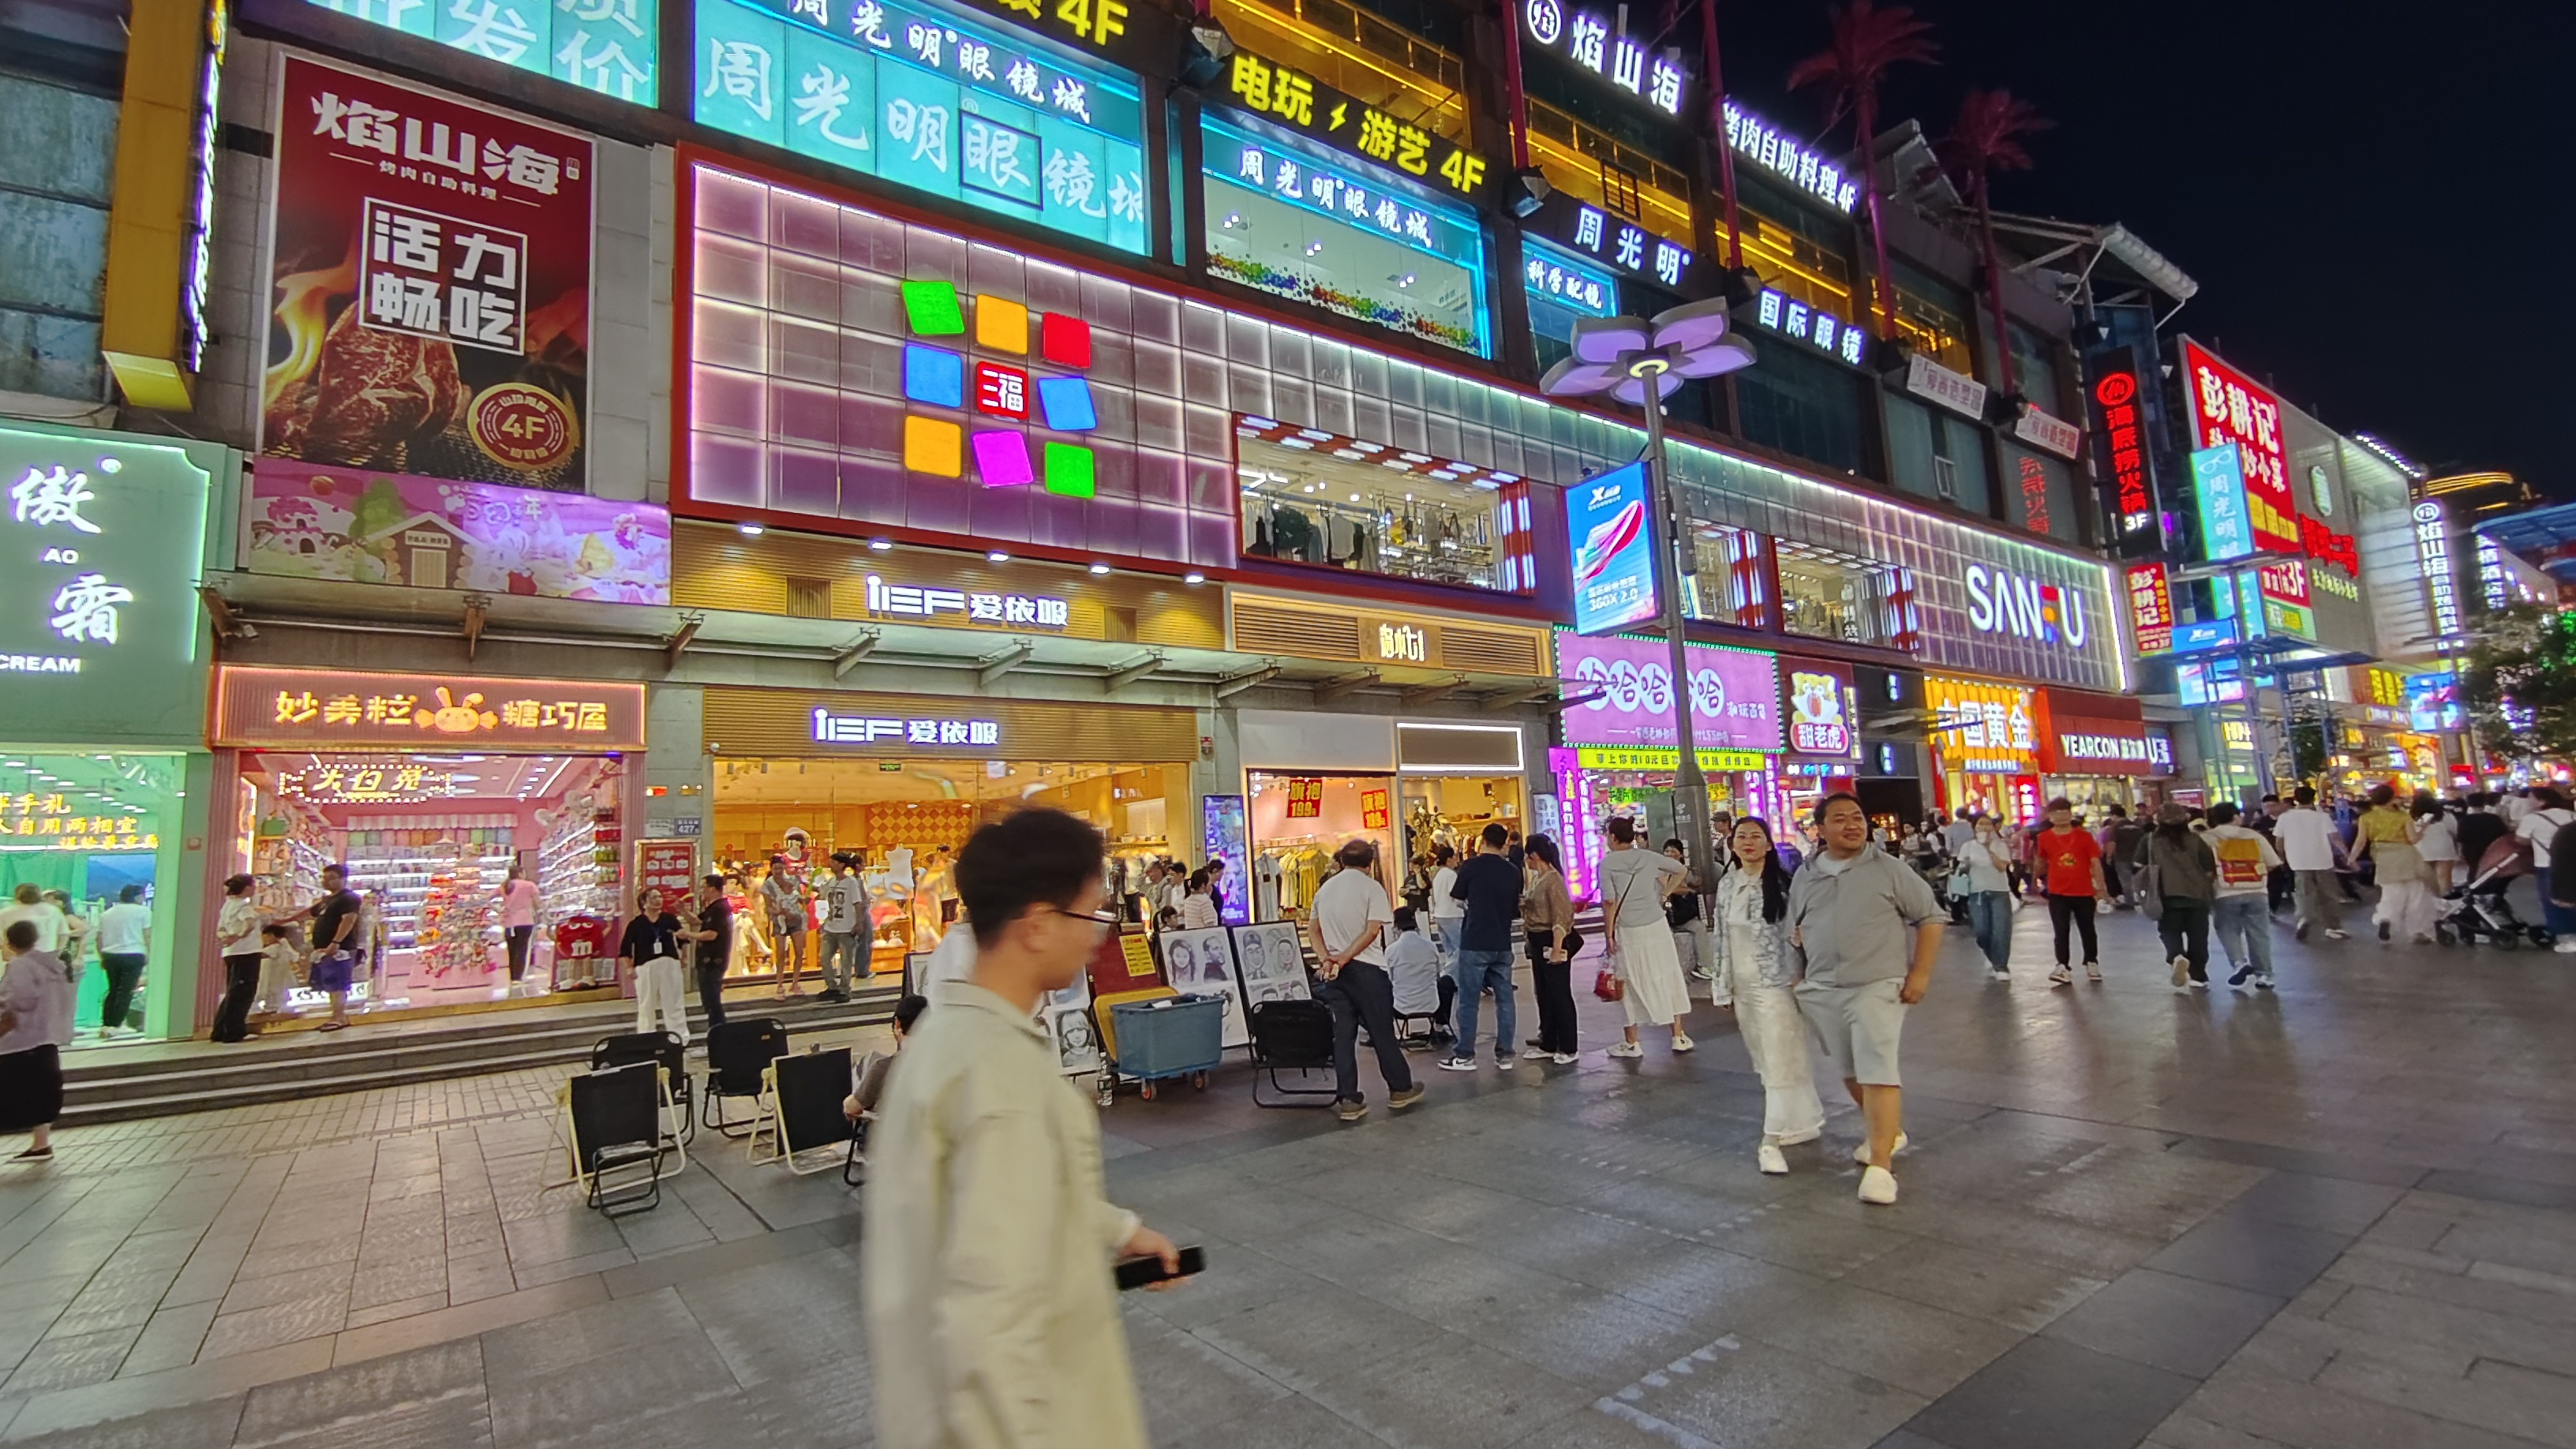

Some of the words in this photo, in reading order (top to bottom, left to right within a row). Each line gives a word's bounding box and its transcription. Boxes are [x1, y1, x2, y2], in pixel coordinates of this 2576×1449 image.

[1572, 14, 1683, 114] 焰山海
[311, 92, 560, 195] 焰山海
[1232, 54, 1313, 126] 电玩
[1357, 109, 1432, 175] 游艺
[1440, 150, 1485, 193] 4F
[1240, 149, 1433, 249] 周光明眼镜城
[373, 209, 517, 290] 活力
[1574, 207, 1684, 286] 周光明
[370, 271, 516, 347] 畅吃
[1527, 260, 1603, 310] 科学配镜
[1759, 290, 1864, 365] 国际眼镜
[982, 369, 1024, 413] 三福
[501, 414, 546, 440] 4F
[10, 466, 103, 534] 傲
[2125, 514, 2147, 532] 3F
[43, 548, 80, 564] AO
[51, 574, 134, 644] 霜
[969, 593, 1069, 626] 爱依服
[275, 691, 413, 725] 妙美粒
[503, 699, 608, 731] 糖巧屋
[908, 719, 999, 745] 爱依服
[2061, 735, 2120, 759] YEARCON
[1290, 781, 1321, 801] 旗袍
